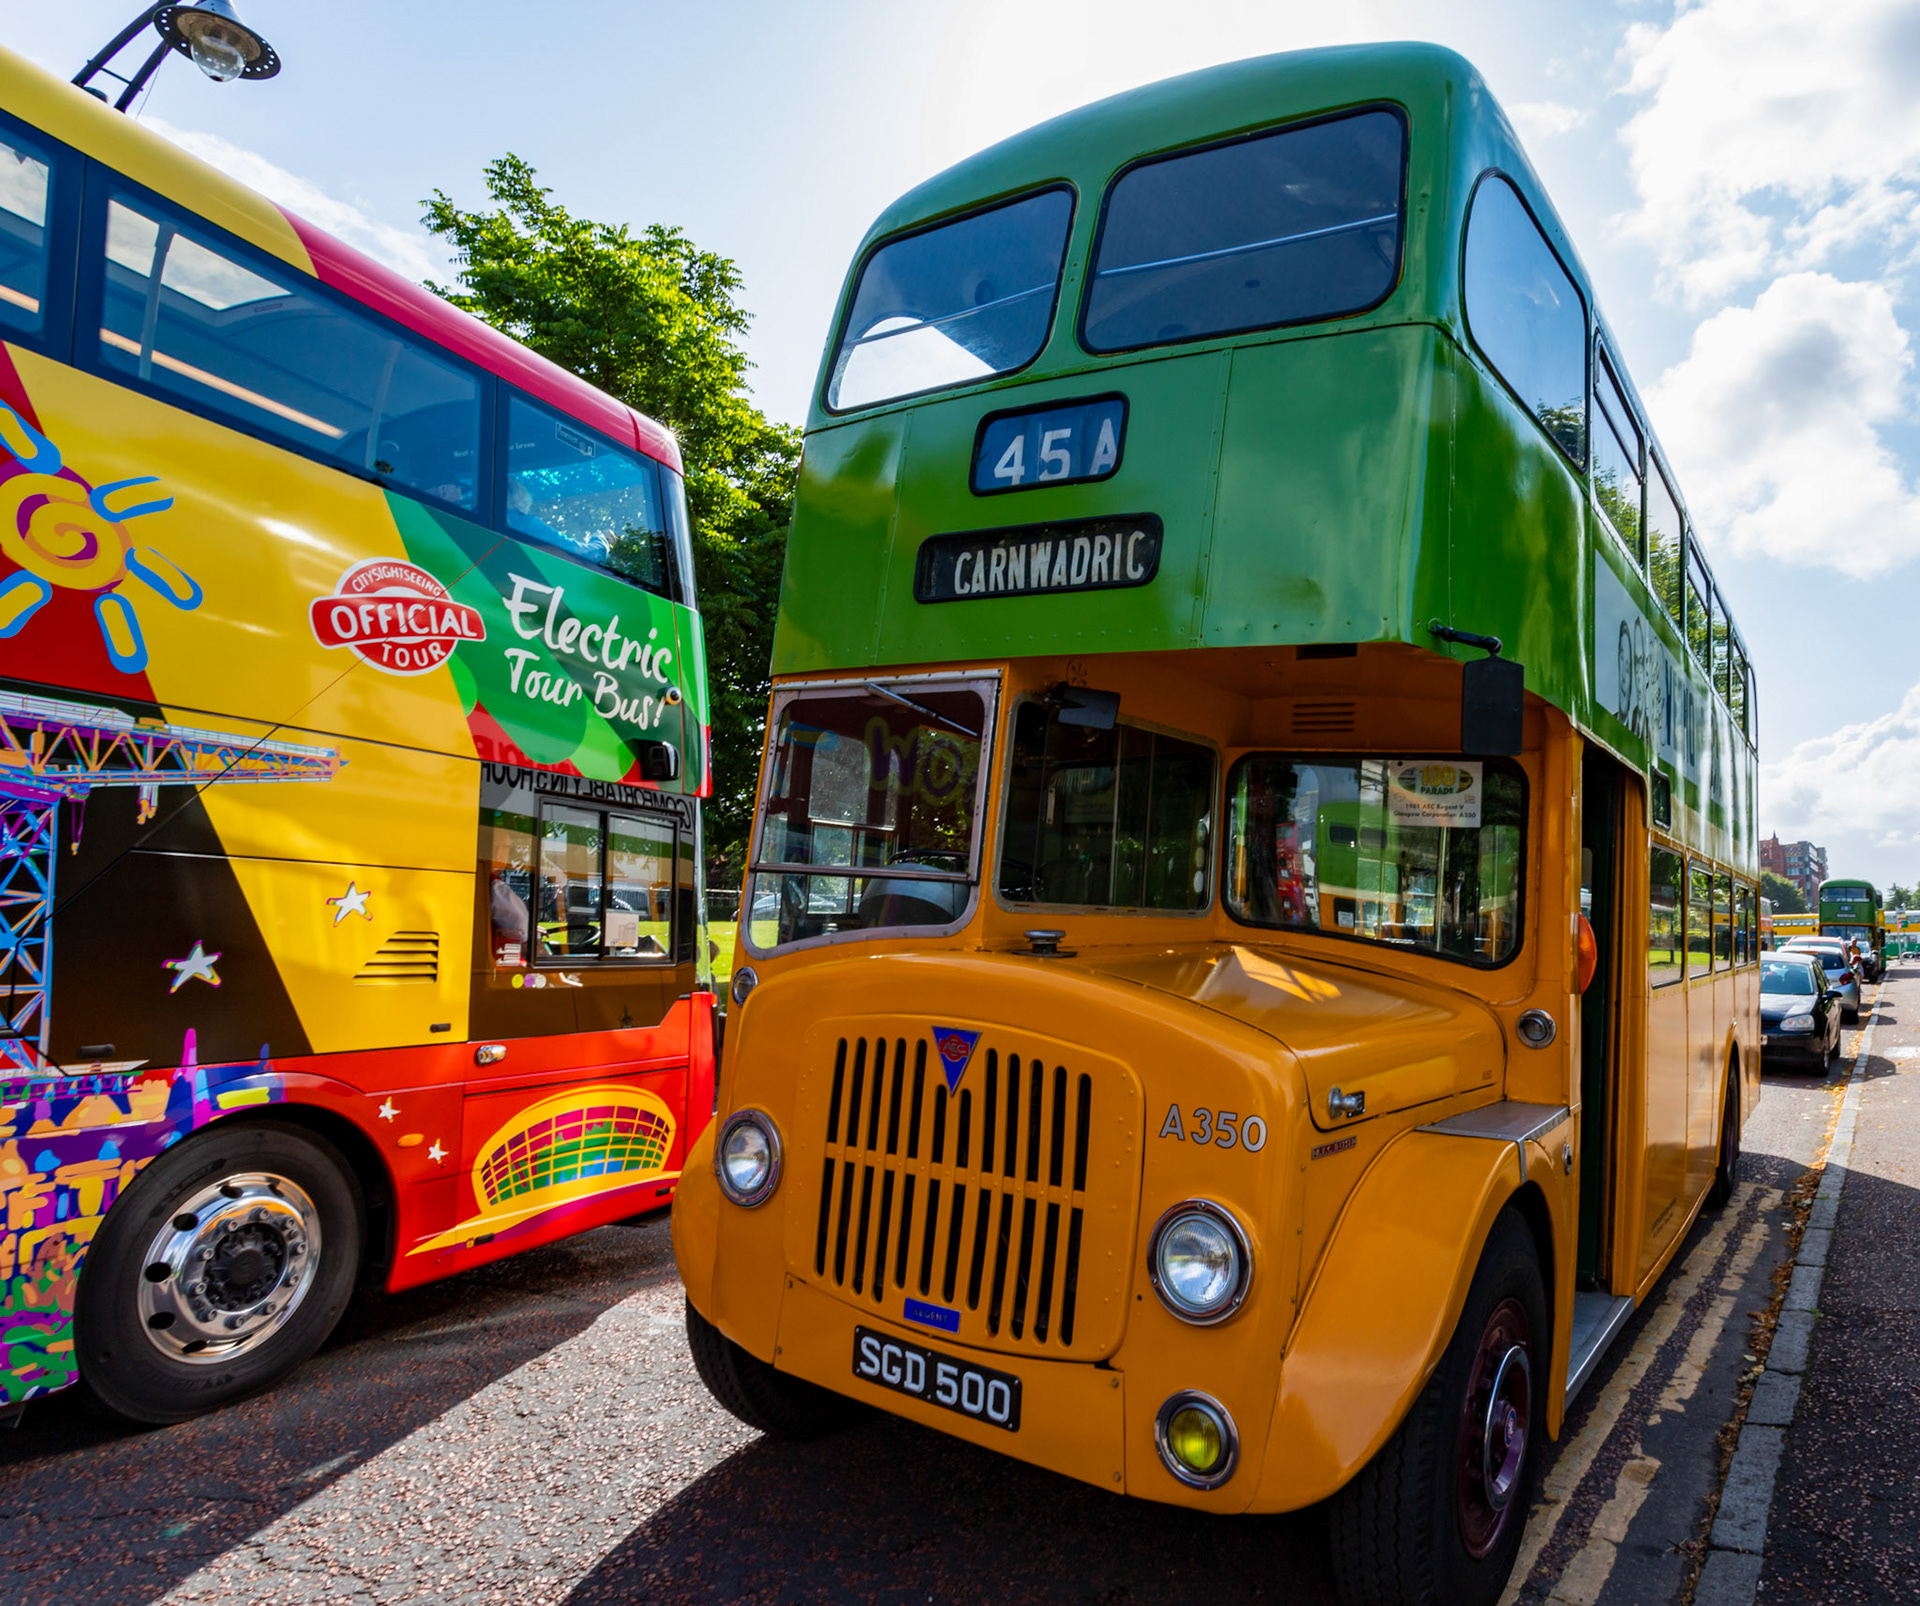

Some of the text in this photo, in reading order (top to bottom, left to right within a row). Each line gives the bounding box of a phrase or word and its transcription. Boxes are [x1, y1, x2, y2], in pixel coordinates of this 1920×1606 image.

[993, 418, 1118, 486] 45A
[351, 565, 442, 597] CITYSIGHTSEEING
[954, 530, 1146, 595] CARNWADRIC
[330, 602, 478, 640] OFFICIAL
[502, 572, 672, 684] Electric
[382, 642, 446, 667] TOUR
[504, 647, 667, 730] Tour Bus!
[1419, 765, 1456, 787] 100
[1421, 787, 1454, 795] PARADE
[1158, 1103, 1268, 1153] A350
[859, 1335, 1012, 1423] SGD 500
